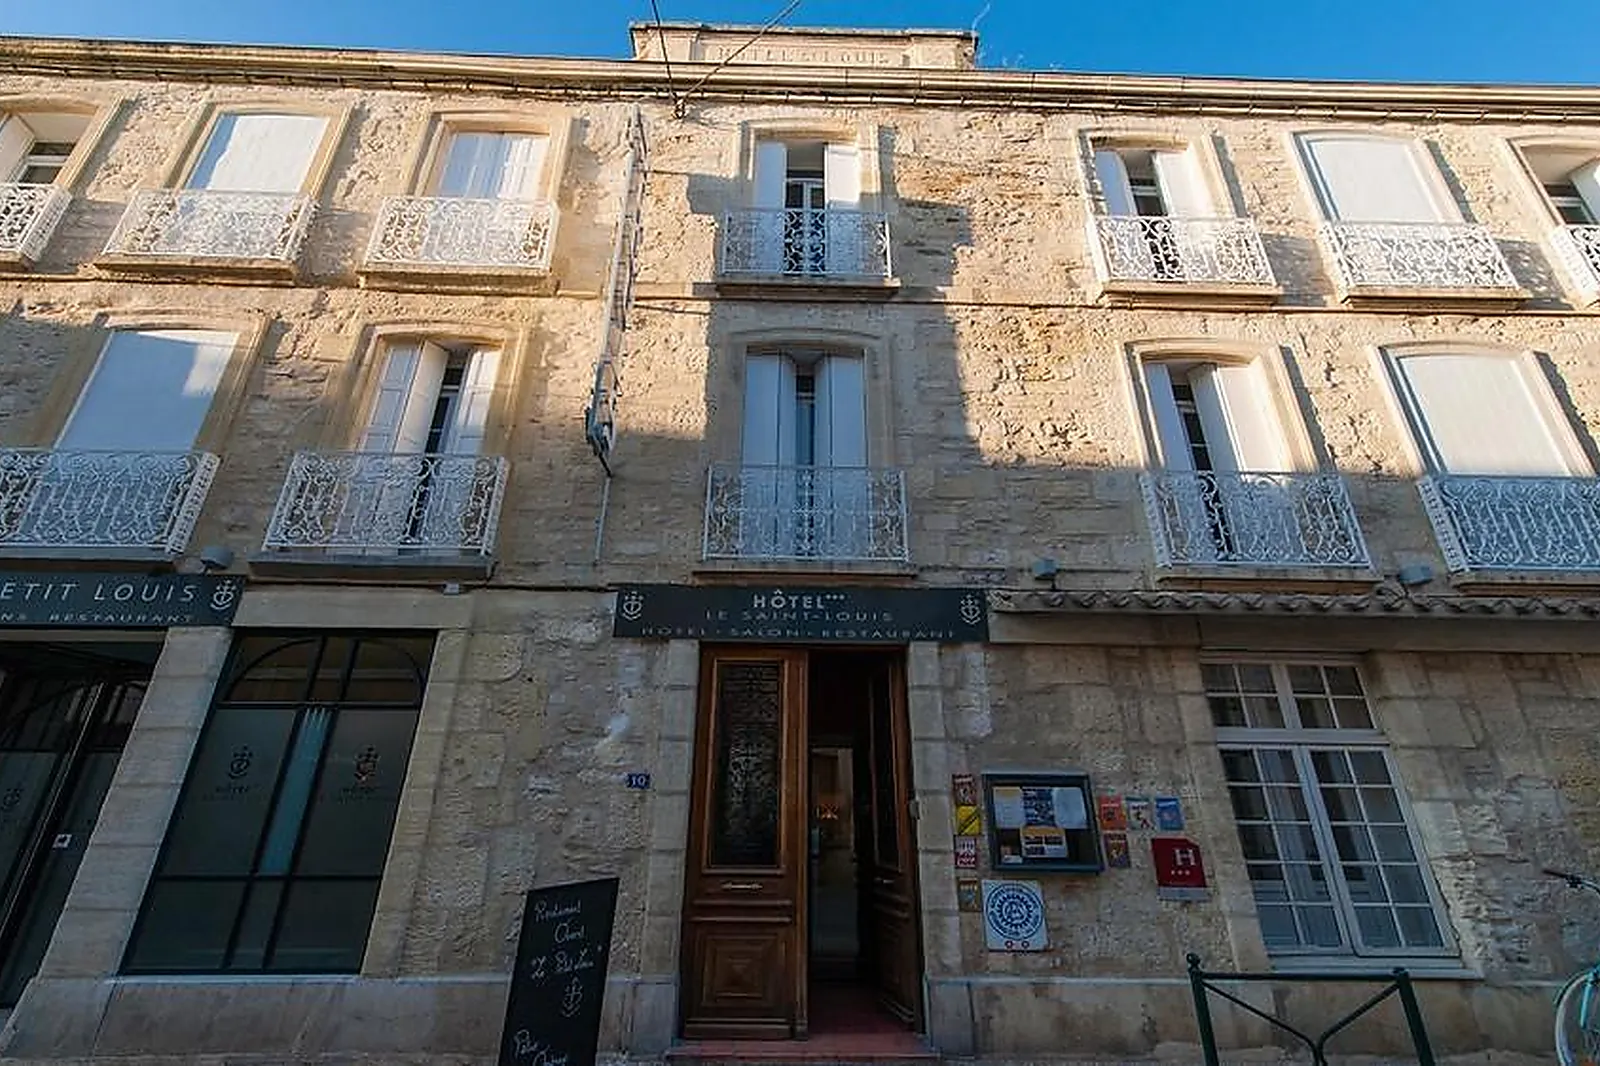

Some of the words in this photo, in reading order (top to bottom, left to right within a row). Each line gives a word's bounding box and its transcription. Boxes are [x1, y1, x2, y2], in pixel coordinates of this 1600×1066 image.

[94, 583, 200, 602] LOUIS
[49, 612, 191, 624] RESTAURANT
[705, 609, 728, 621] LE
[742, 608, 894, 622] SAINT-LOUIS
[821, 628, 954, 640] RESTAURANT
[631, 775, 647, 787] 10
[1174, 848, 1196, 867] H
